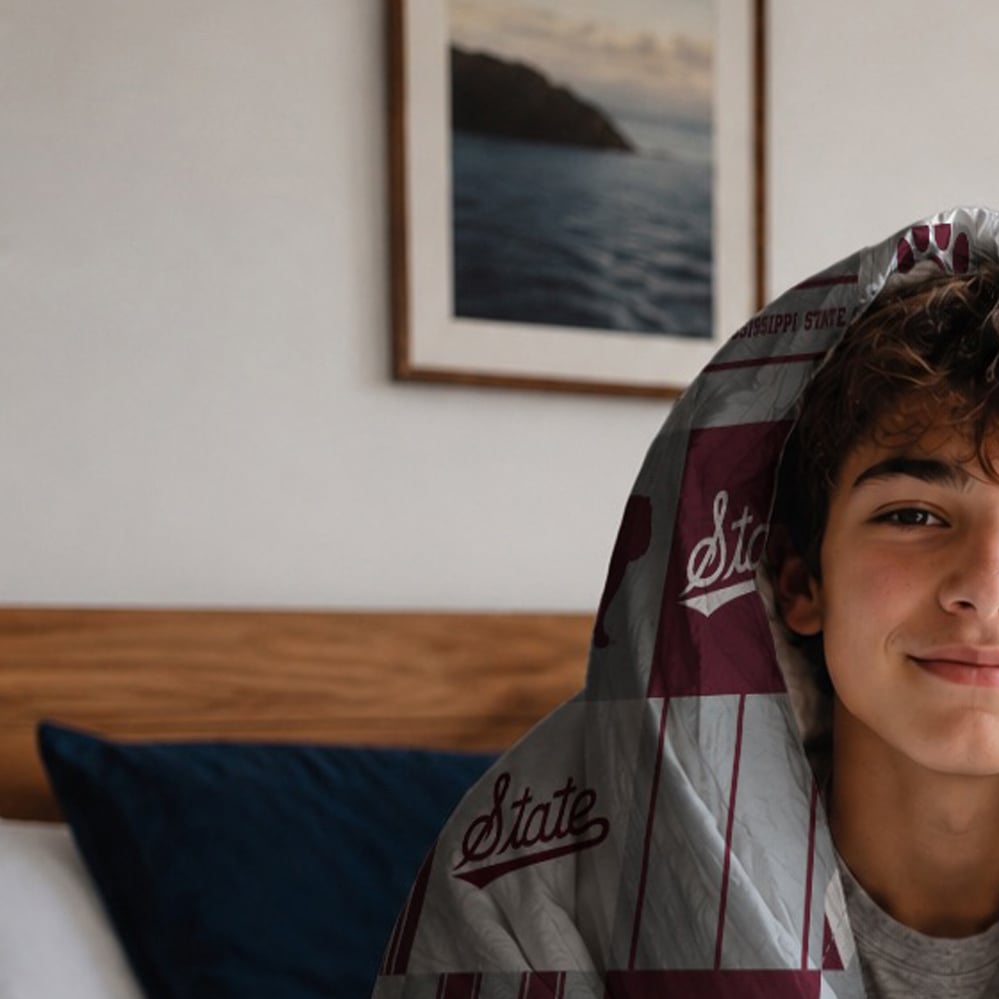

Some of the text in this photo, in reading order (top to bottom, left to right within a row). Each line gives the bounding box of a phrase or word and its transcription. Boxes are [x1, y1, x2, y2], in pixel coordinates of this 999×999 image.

[804, 307, 847, 332] STATE
[679, 489, 769, 598] Sta
[453, 773, 609, 889] State
